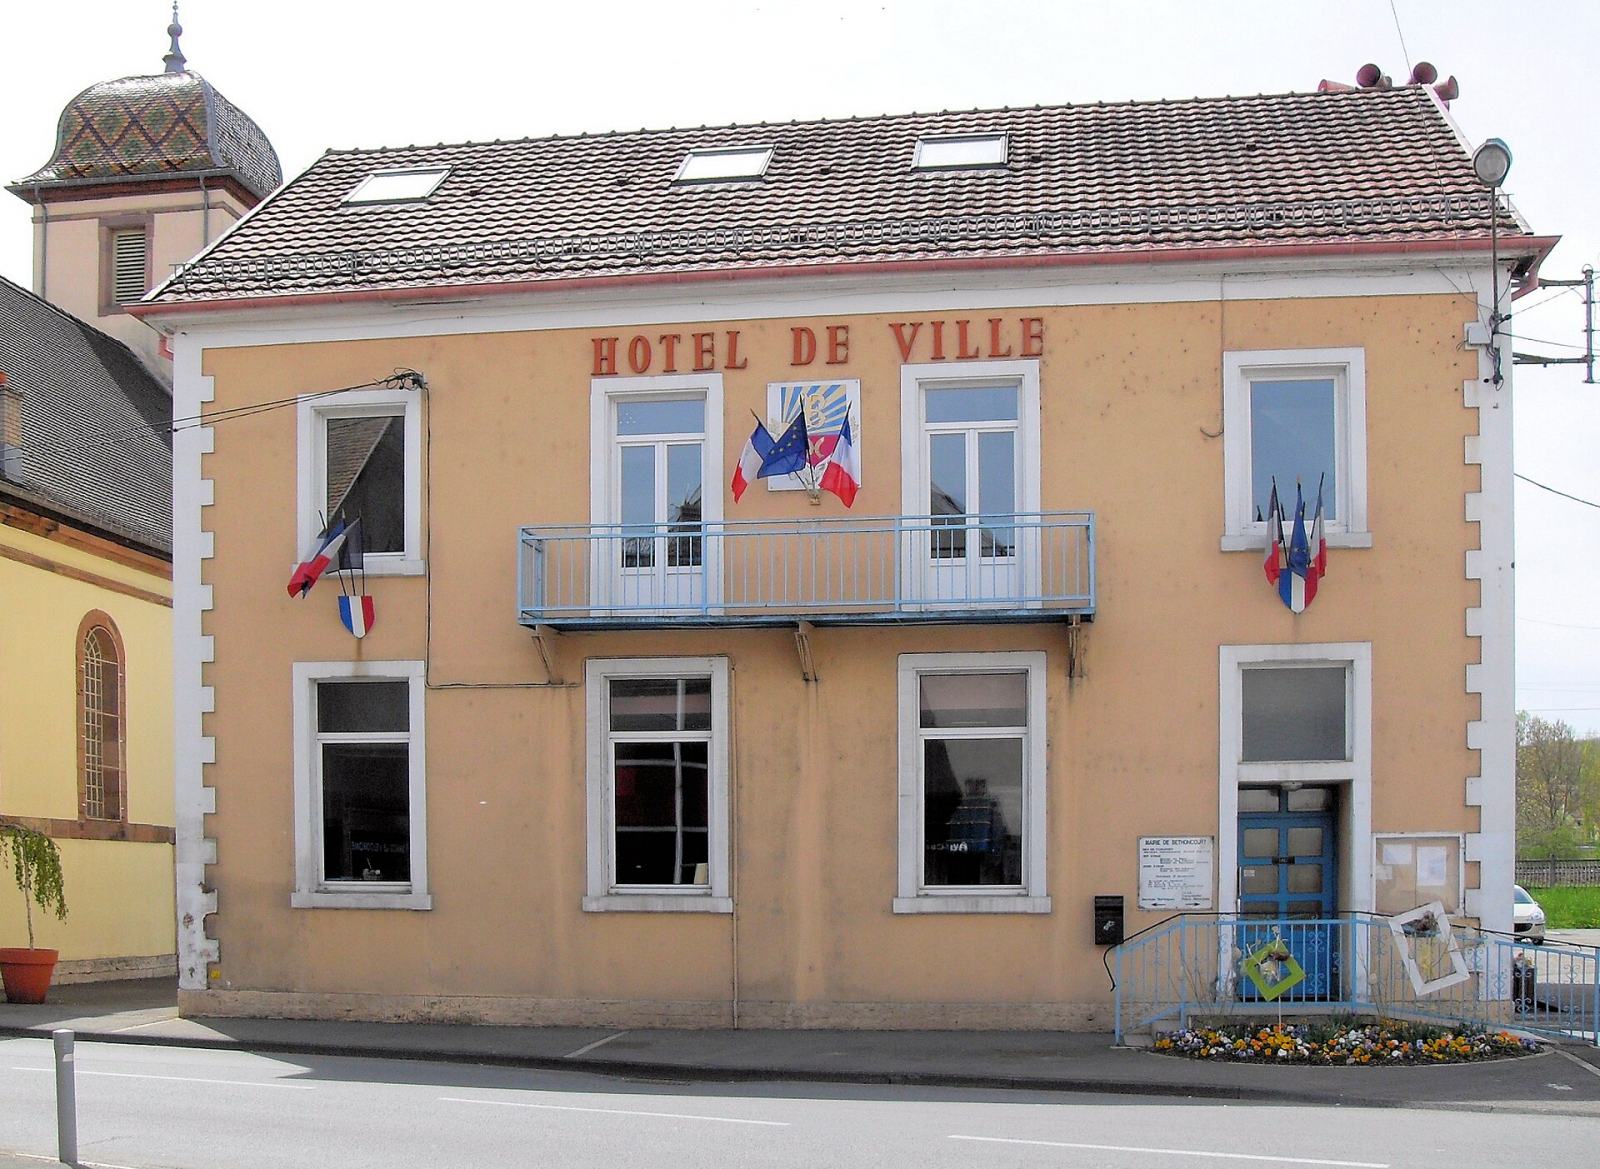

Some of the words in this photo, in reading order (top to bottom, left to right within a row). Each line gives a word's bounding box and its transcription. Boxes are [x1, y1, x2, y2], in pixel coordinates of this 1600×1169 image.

[591, 330, 747, 376] HOTEL
[790, 325, 849, 366] DE
[888, 317, 1044, 363] VILLE
